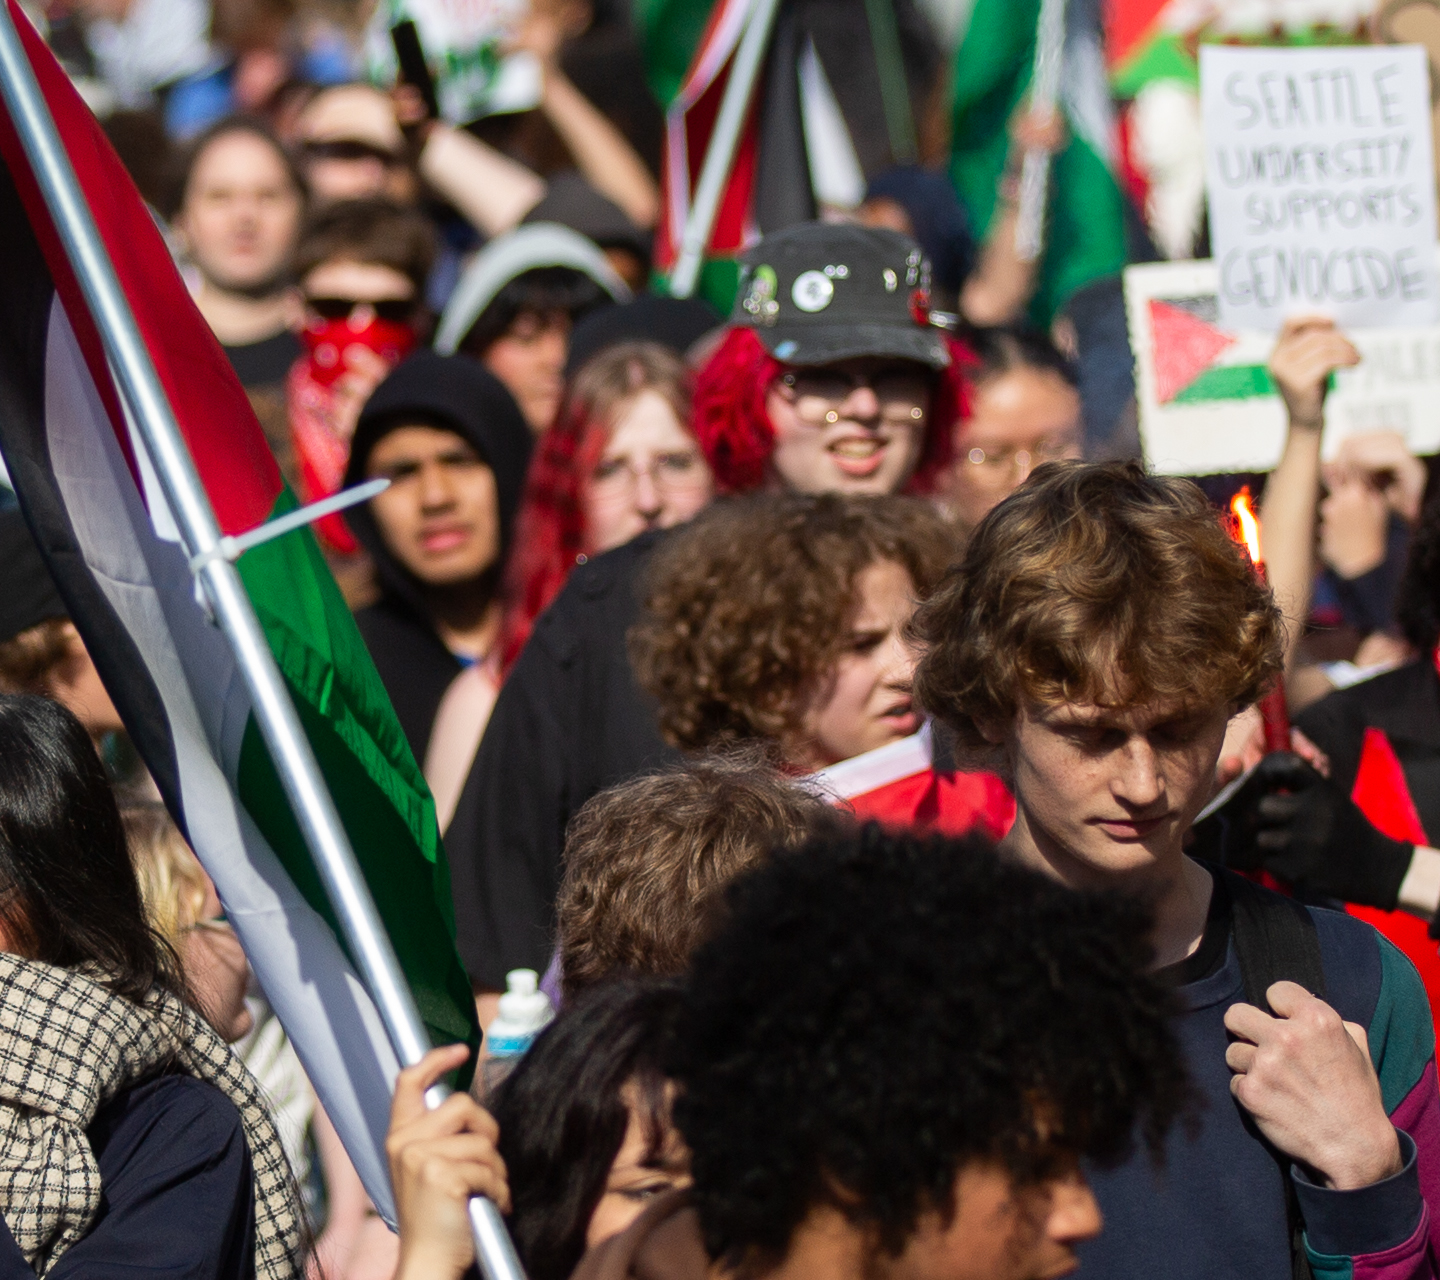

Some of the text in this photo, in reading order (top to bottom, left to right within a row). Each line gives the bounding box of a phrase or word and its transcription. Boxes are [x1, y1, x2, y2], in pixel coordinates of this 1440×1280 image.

[1223, 62, 1407, 130] SEATTLE
[1216, 131, 1413, 189] UNIVERSITY
[1244, 182, 1423, 235] SUPPORTS
[1220, 244, 1431, 307] GENOCIDE
